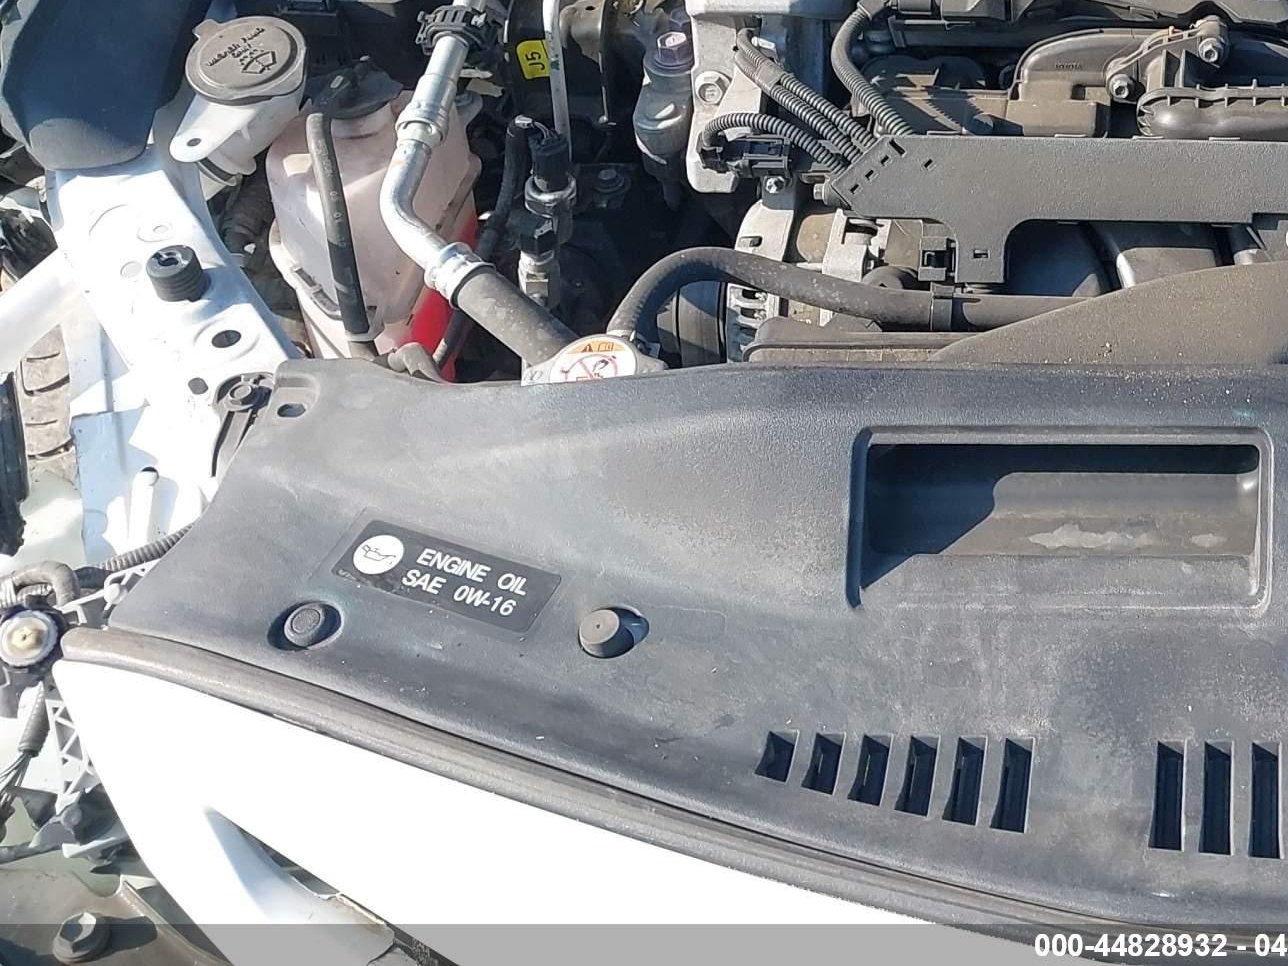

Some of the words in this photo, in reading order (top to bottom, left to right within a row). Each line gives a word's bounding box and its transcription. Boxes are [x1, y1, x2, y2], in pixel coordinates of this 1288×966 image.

[524, 50, 546, 72] J5
[401, 569, 447, 595] SAE
[452, 584, 517, 617] 0W-16
[416, 547, 492, 583] ENGINE
[497, 573, 528, 597] OIL
